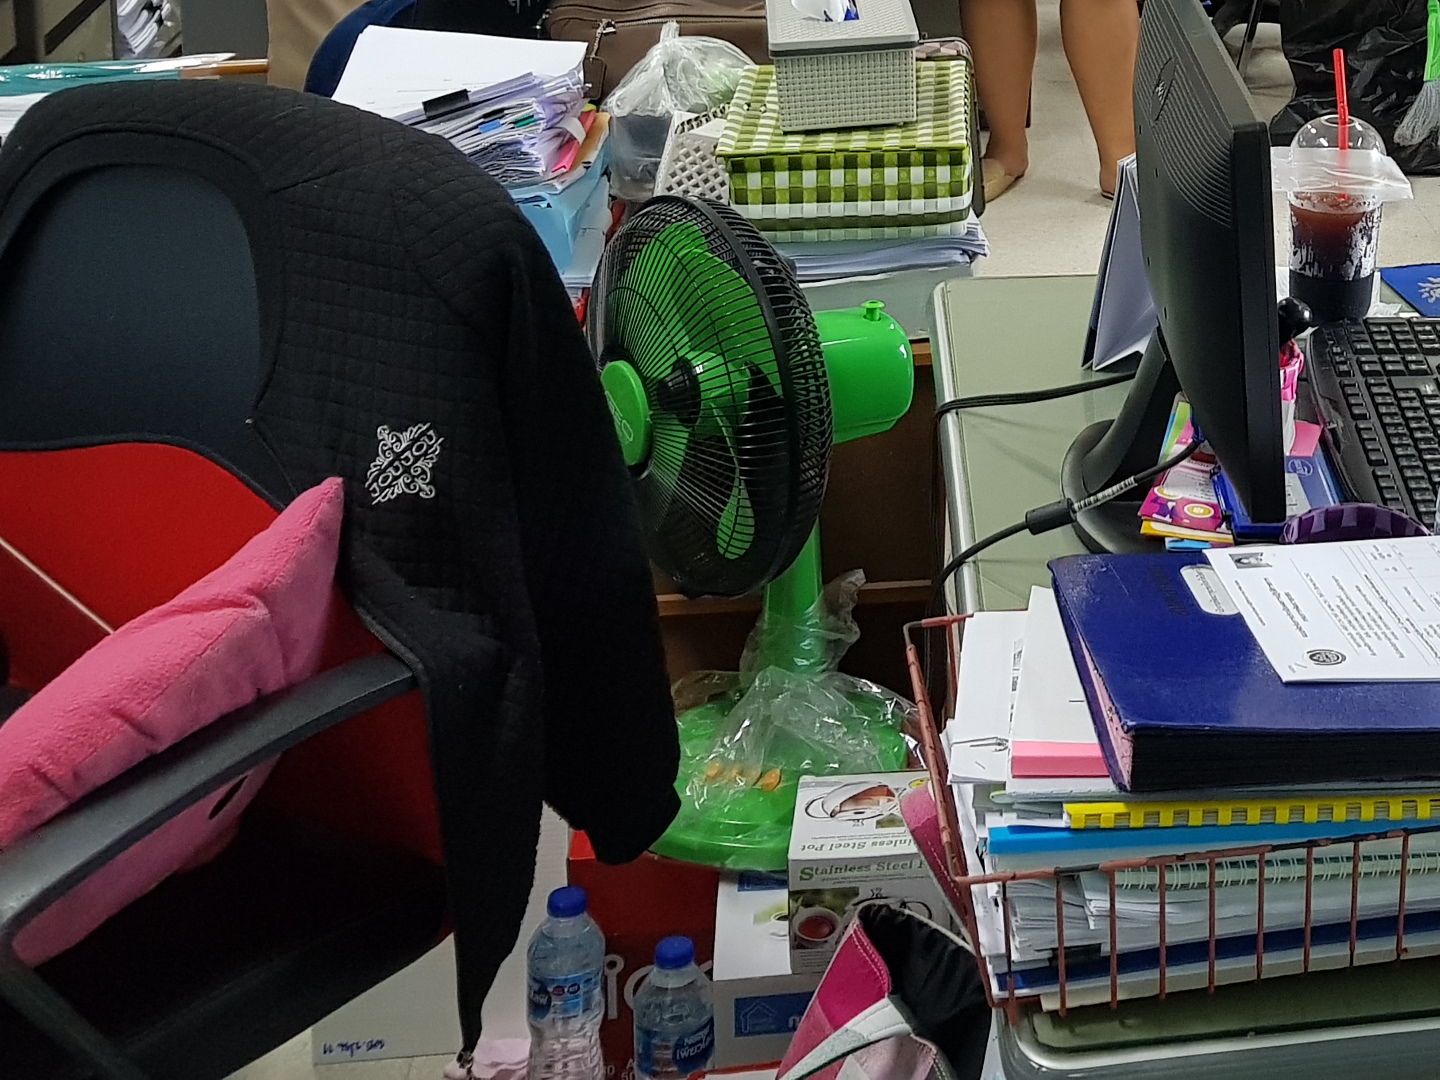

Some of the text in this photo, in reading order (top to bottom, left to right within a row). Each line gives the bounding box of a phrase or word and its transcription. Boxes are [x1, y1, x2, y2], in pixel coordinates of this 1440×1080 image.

[801, 838, 917, 852] inless Steel Pot
[799, 862, 871, 882] Stainless
[876, 859, 913, 871] Steel
